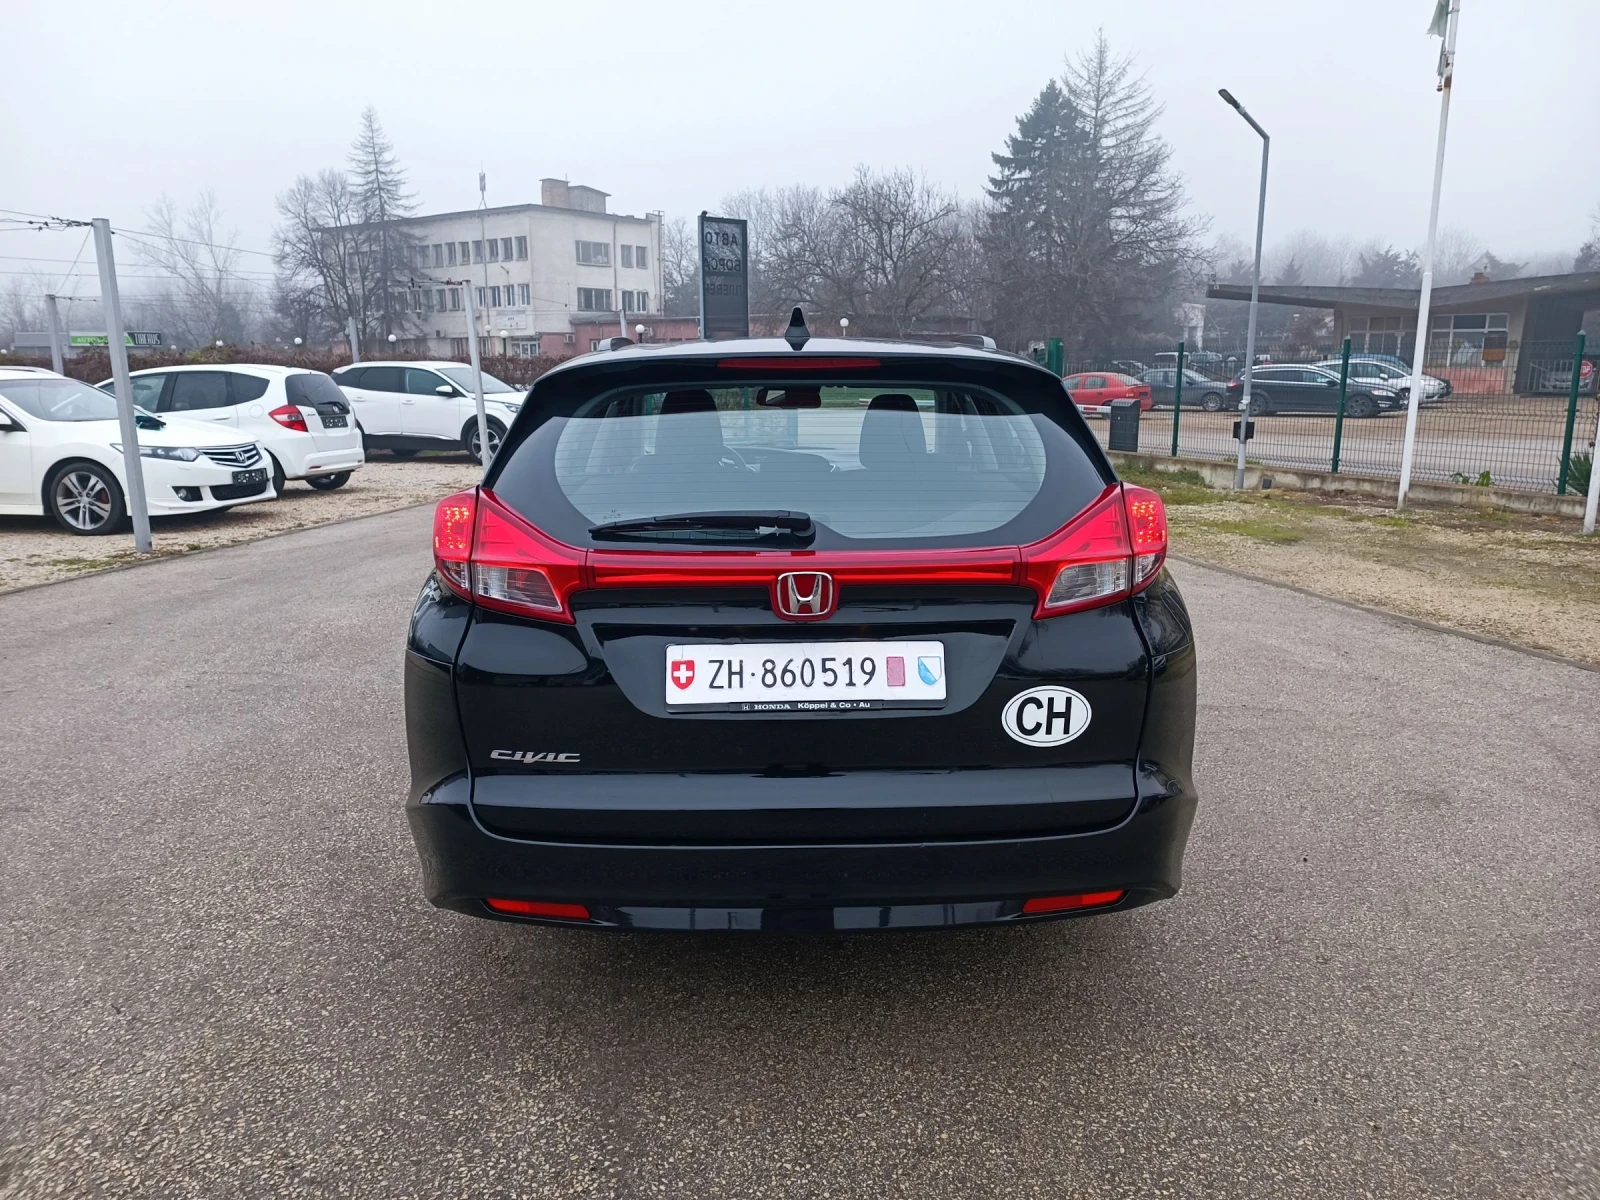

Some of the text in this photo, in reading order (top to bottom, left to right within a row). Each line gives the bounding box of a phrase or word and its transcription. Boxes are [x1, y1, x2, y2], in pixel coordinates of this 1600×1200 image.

[797, 702, 828, 710] Köppel
[1016, 696, 1072, 736] CH
[490, 749, 581, 764] CIVIC
